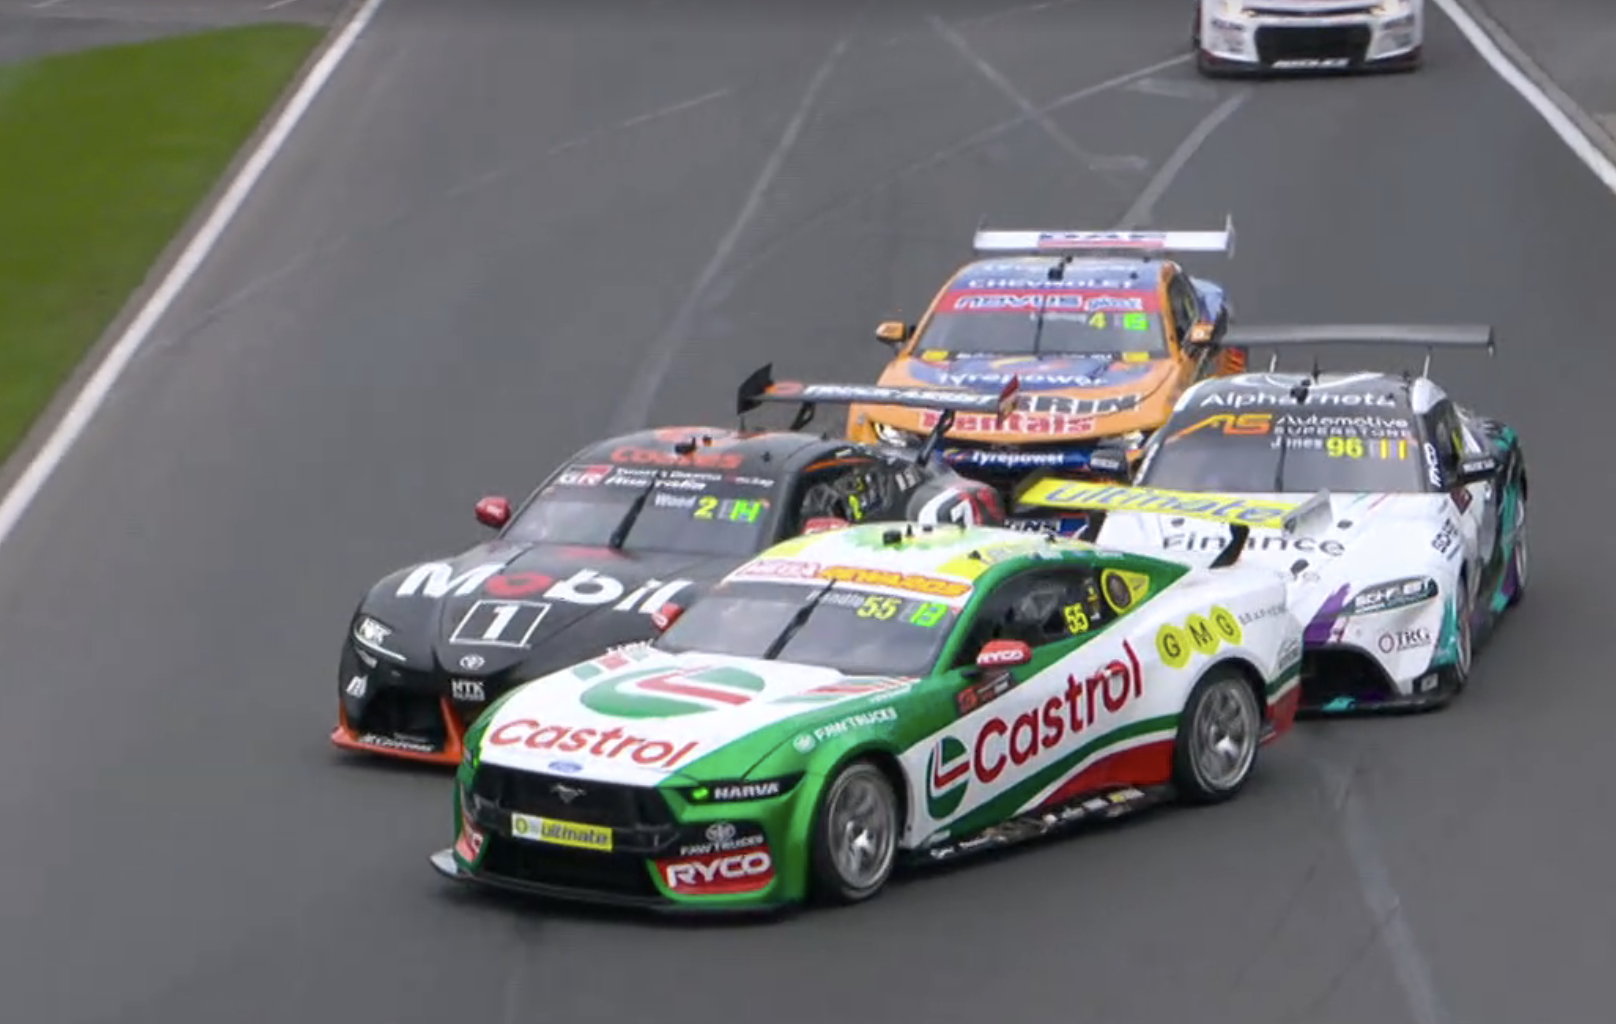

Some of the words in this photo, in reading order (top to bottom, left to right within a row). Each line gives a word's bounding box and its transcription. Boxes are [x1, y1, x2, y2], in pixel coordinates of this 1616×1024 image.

[1089, 311, 1107, 329] 4
[1276, 414, 1409, 429] Automotive
[1271, 437, 1322, 449] Jnes
[1326, 437, 1364, 459] 96
[693, 495, 718, 520] 2
[1163, 532, 1346, 557] Finnce
[396, 562, 693, 614] Mobil
[857, 594, 902, 620] 55
[1064, 604, 1089, 634] 55
[462, 605, 519, 640] 1
[974, 638, 1143, 784] Castrol
[489, 718, 700, 769] Castrol
[714, 781, 780, 799] NARVA
[666, 851, 772, 889] RYCO
